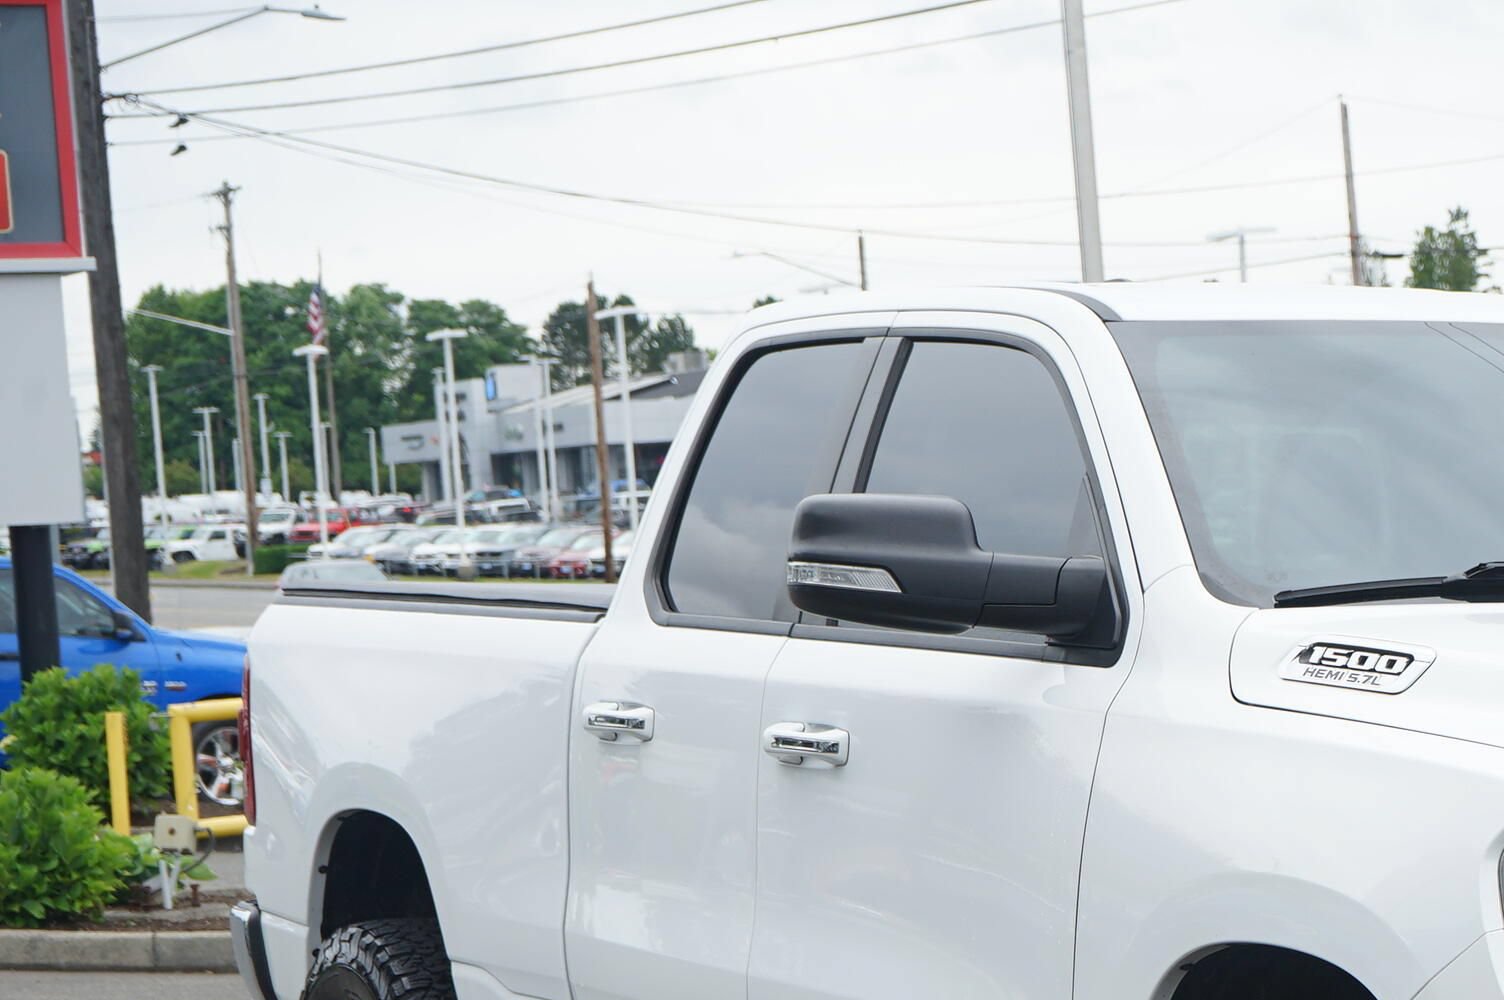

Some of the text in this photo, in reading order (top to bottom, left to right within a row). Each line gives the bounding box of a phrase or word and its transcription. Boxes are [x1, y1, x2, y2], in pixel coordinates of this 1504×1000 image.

[1308, 646, 1409, 674] 1500
[1303, 667, 1381, 685] HEMI 5.7L
